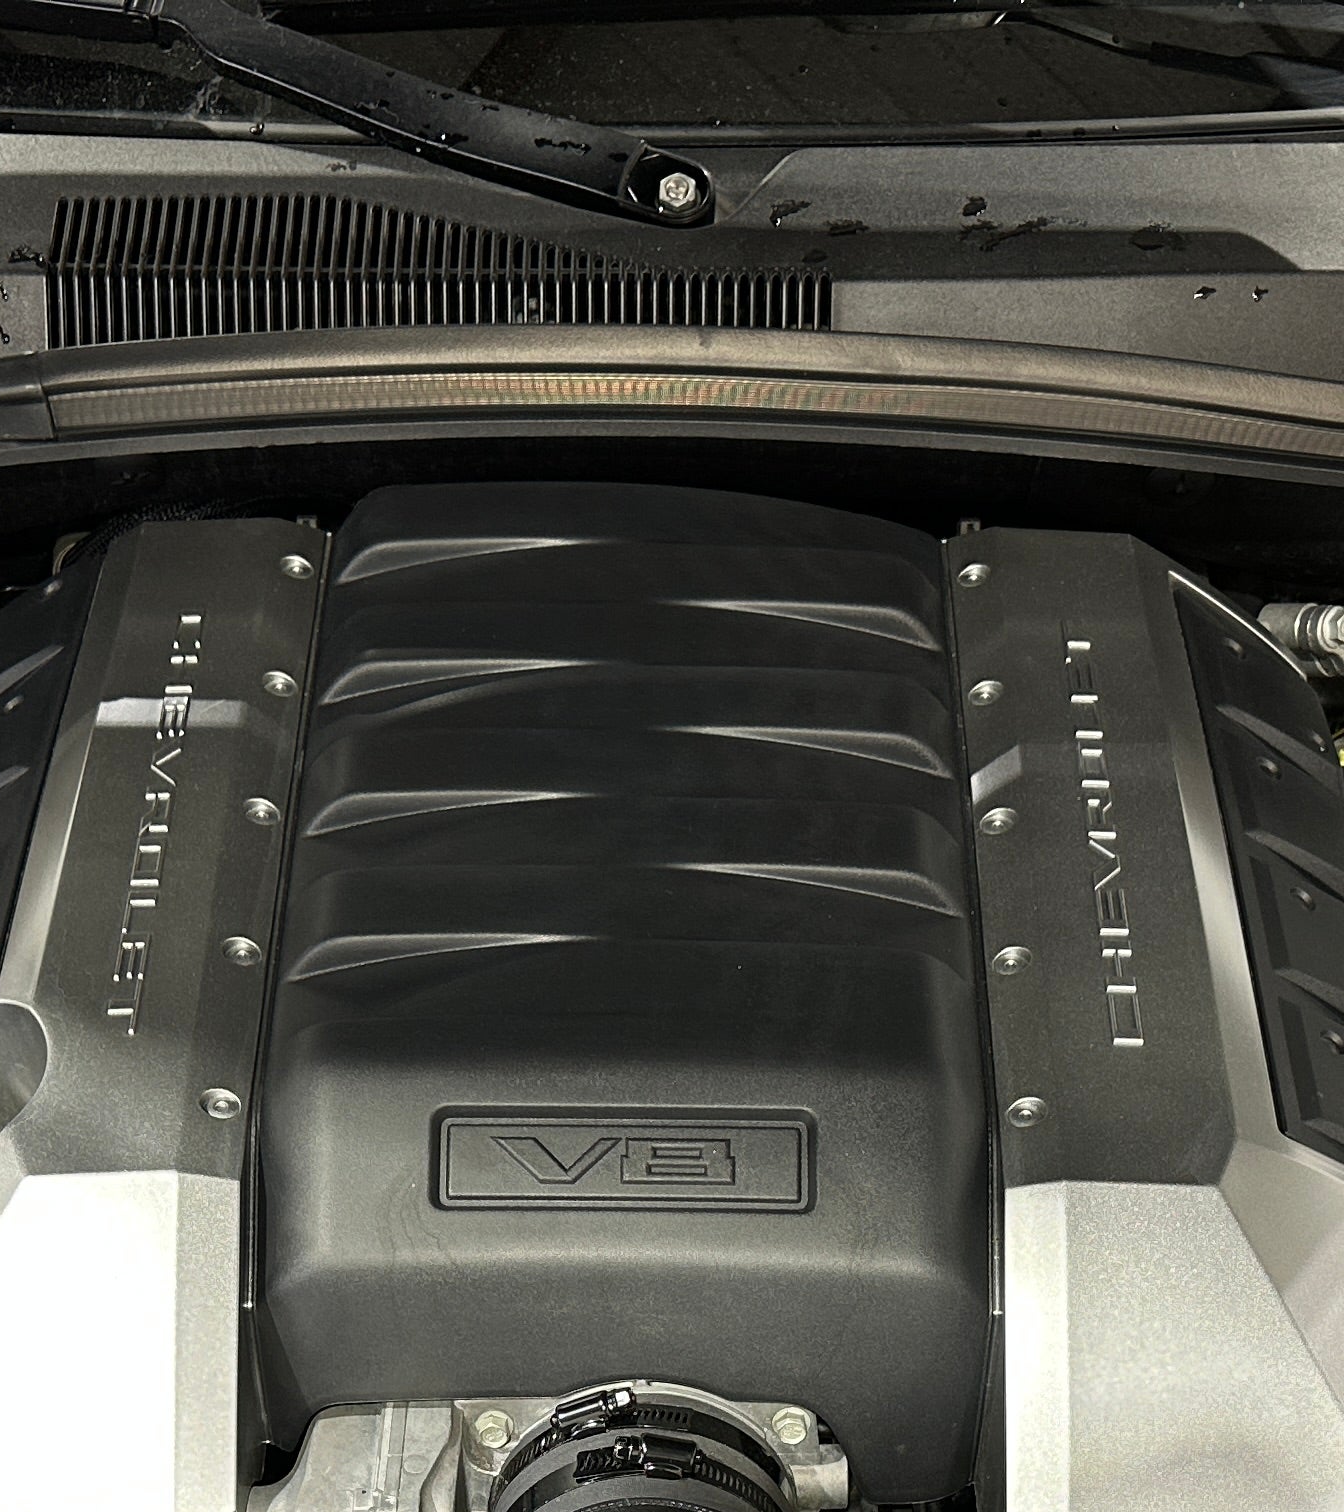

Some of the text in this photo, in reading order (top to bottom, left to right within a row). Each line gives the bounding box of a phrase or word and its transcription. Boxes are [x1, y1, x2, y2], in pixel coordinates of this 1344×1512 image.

[107, 614, 202, 1036] CHEVROLET
[1061, 620, 1144, 1046] CHEVROLET
[491, 1136, 736, 1186] V8
